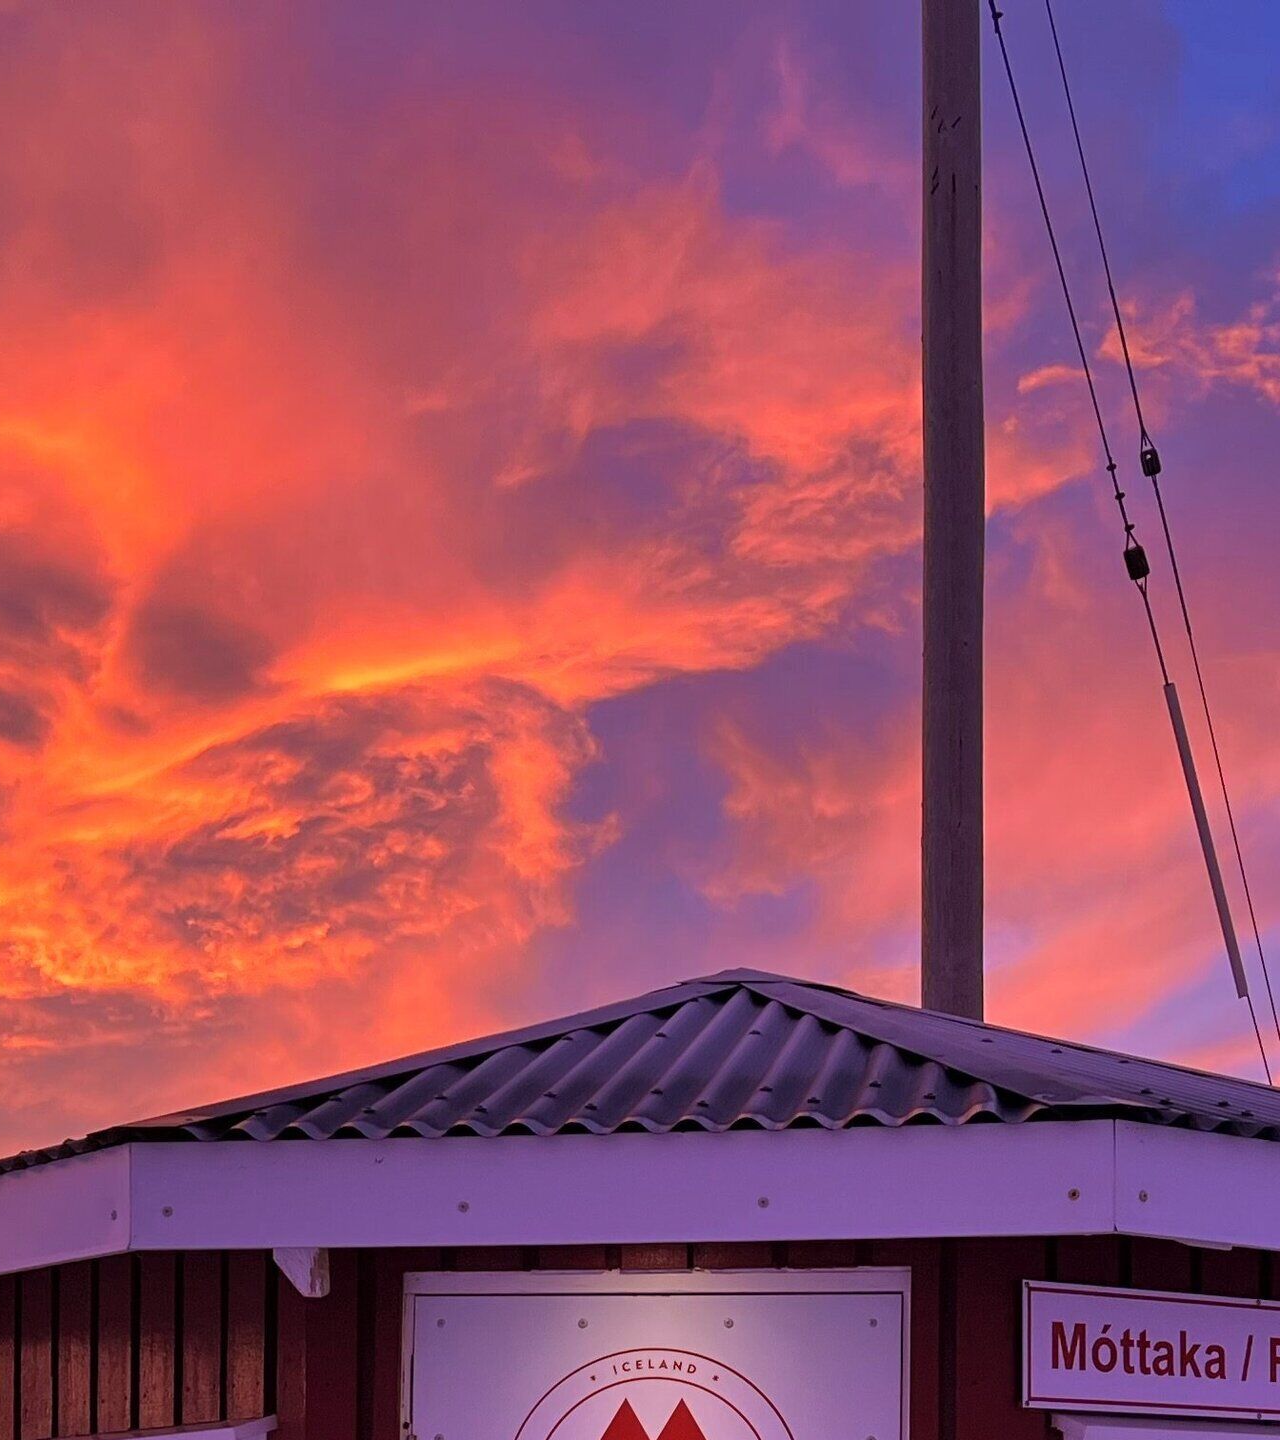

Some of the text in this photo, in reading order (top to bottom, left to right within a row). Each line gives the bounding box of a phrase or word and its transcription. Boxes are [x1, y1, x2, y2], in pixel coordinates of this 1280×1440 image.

[612, 1358, 699, 1376] ICELAND
[1050, 1321, 1227, 1380] Móttaka
[1241, 1334, 1254, 1382] /
